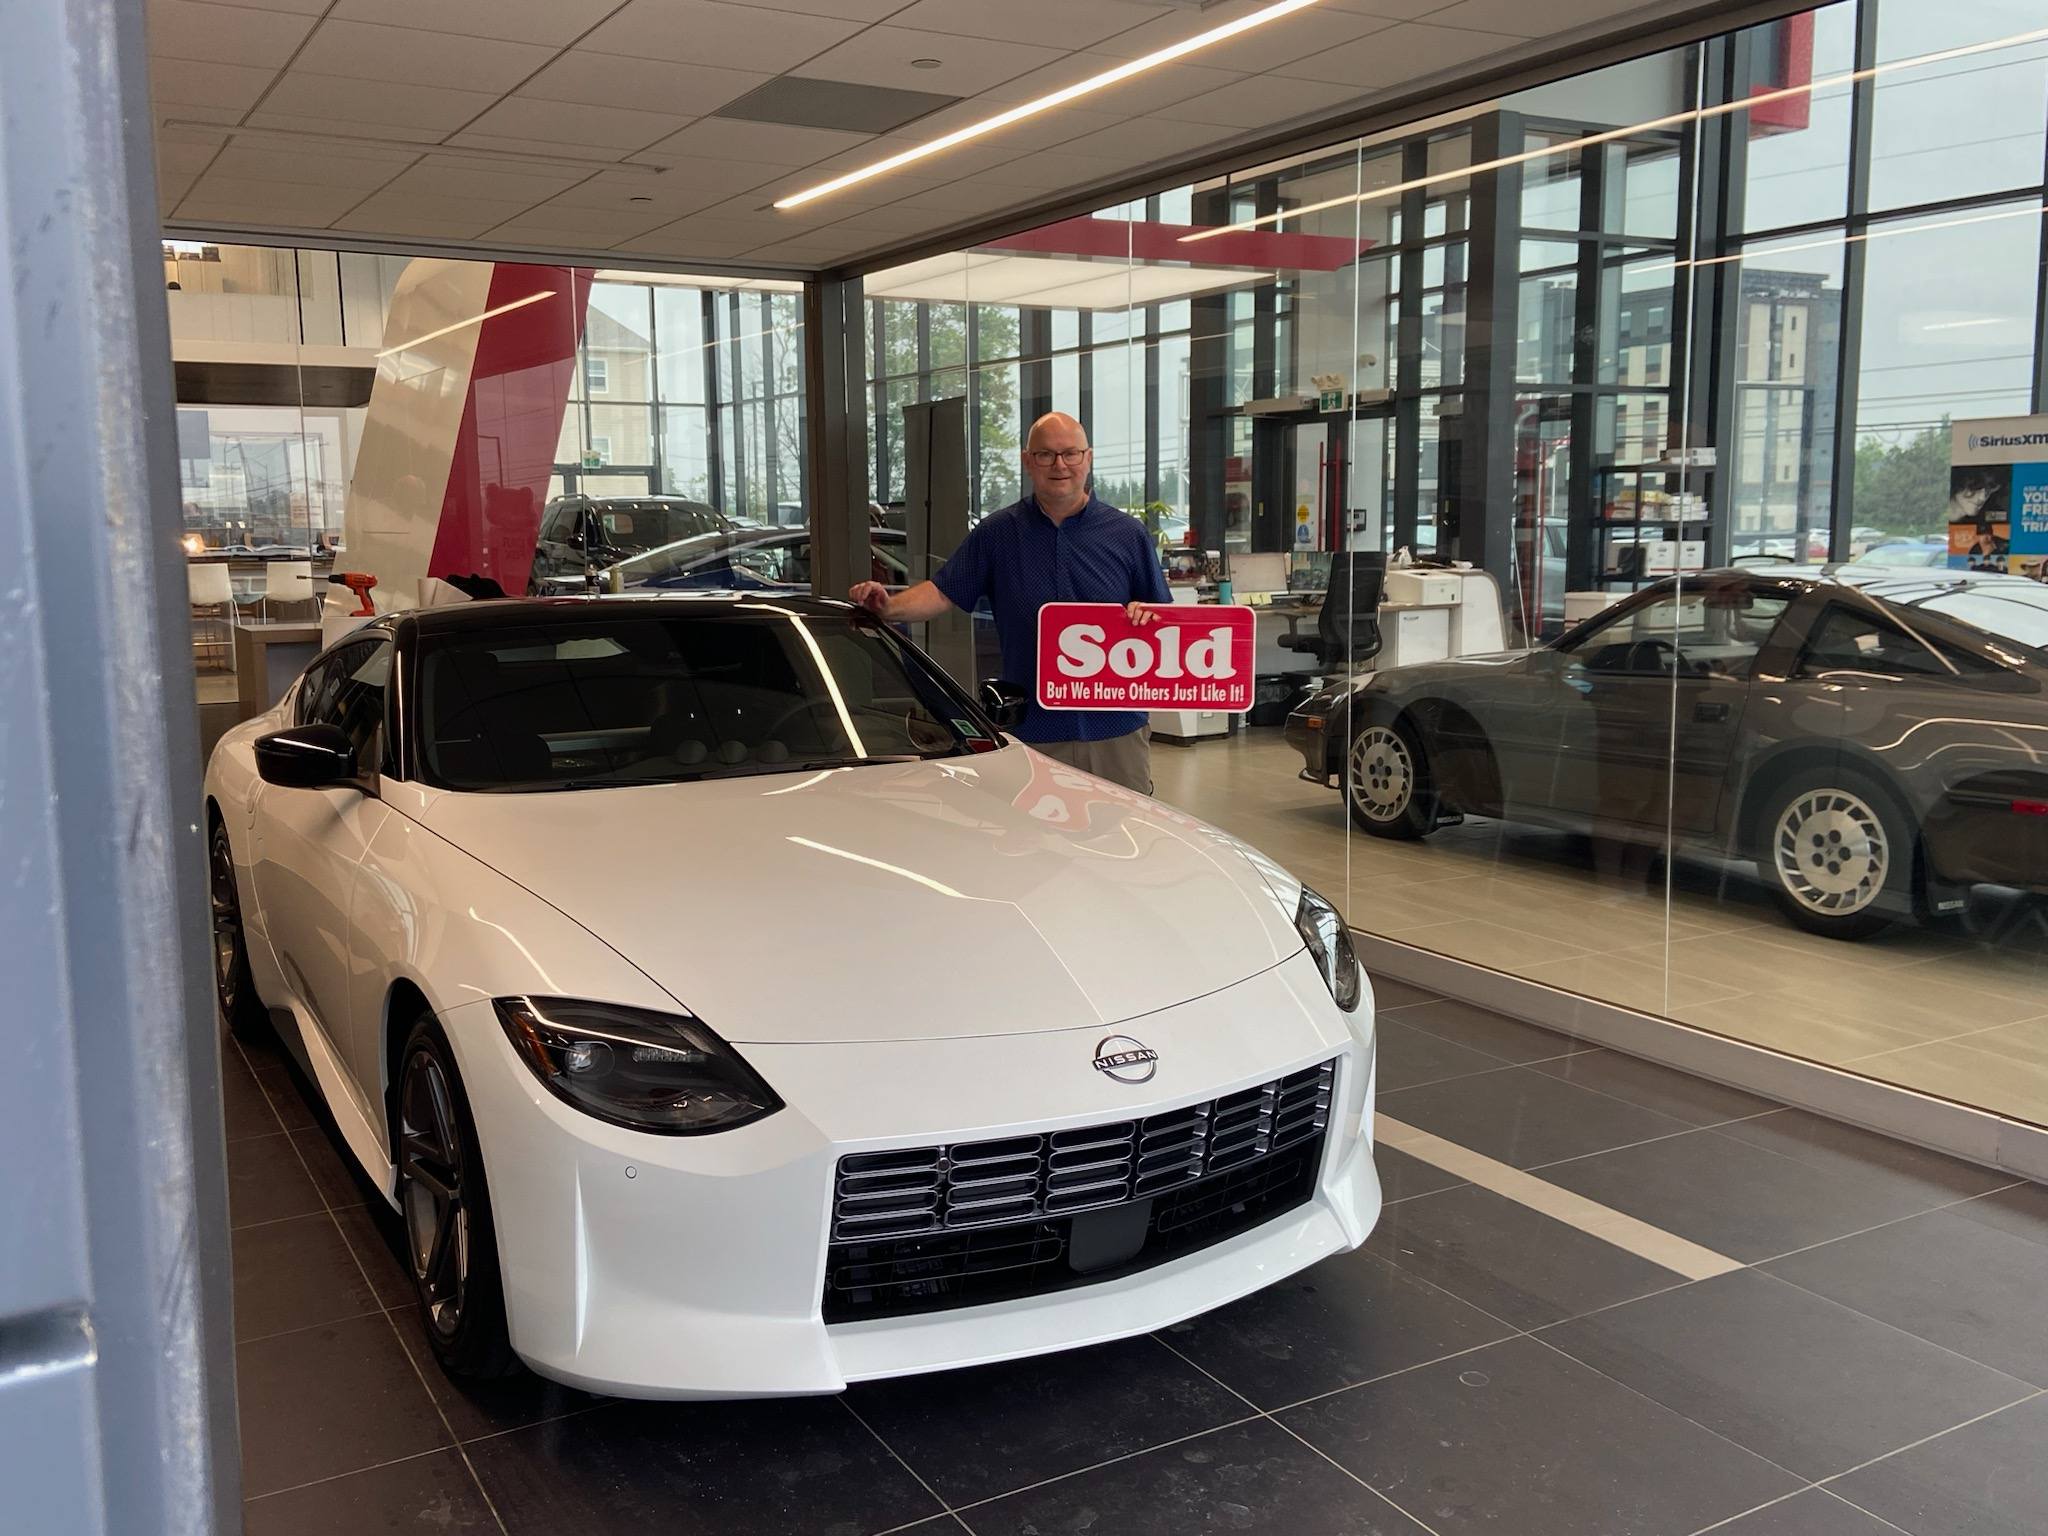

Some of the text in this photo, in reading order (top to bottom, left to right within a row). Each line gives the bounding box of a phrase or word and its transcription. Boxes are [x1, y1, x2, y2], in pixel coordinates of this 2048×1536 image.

[1057, 623, 1237, 679] Sold
[1047, 681, 1245, 702] But We Have Others Just Like It!
[1095, 1050, 1157, 1069] NISSAN
